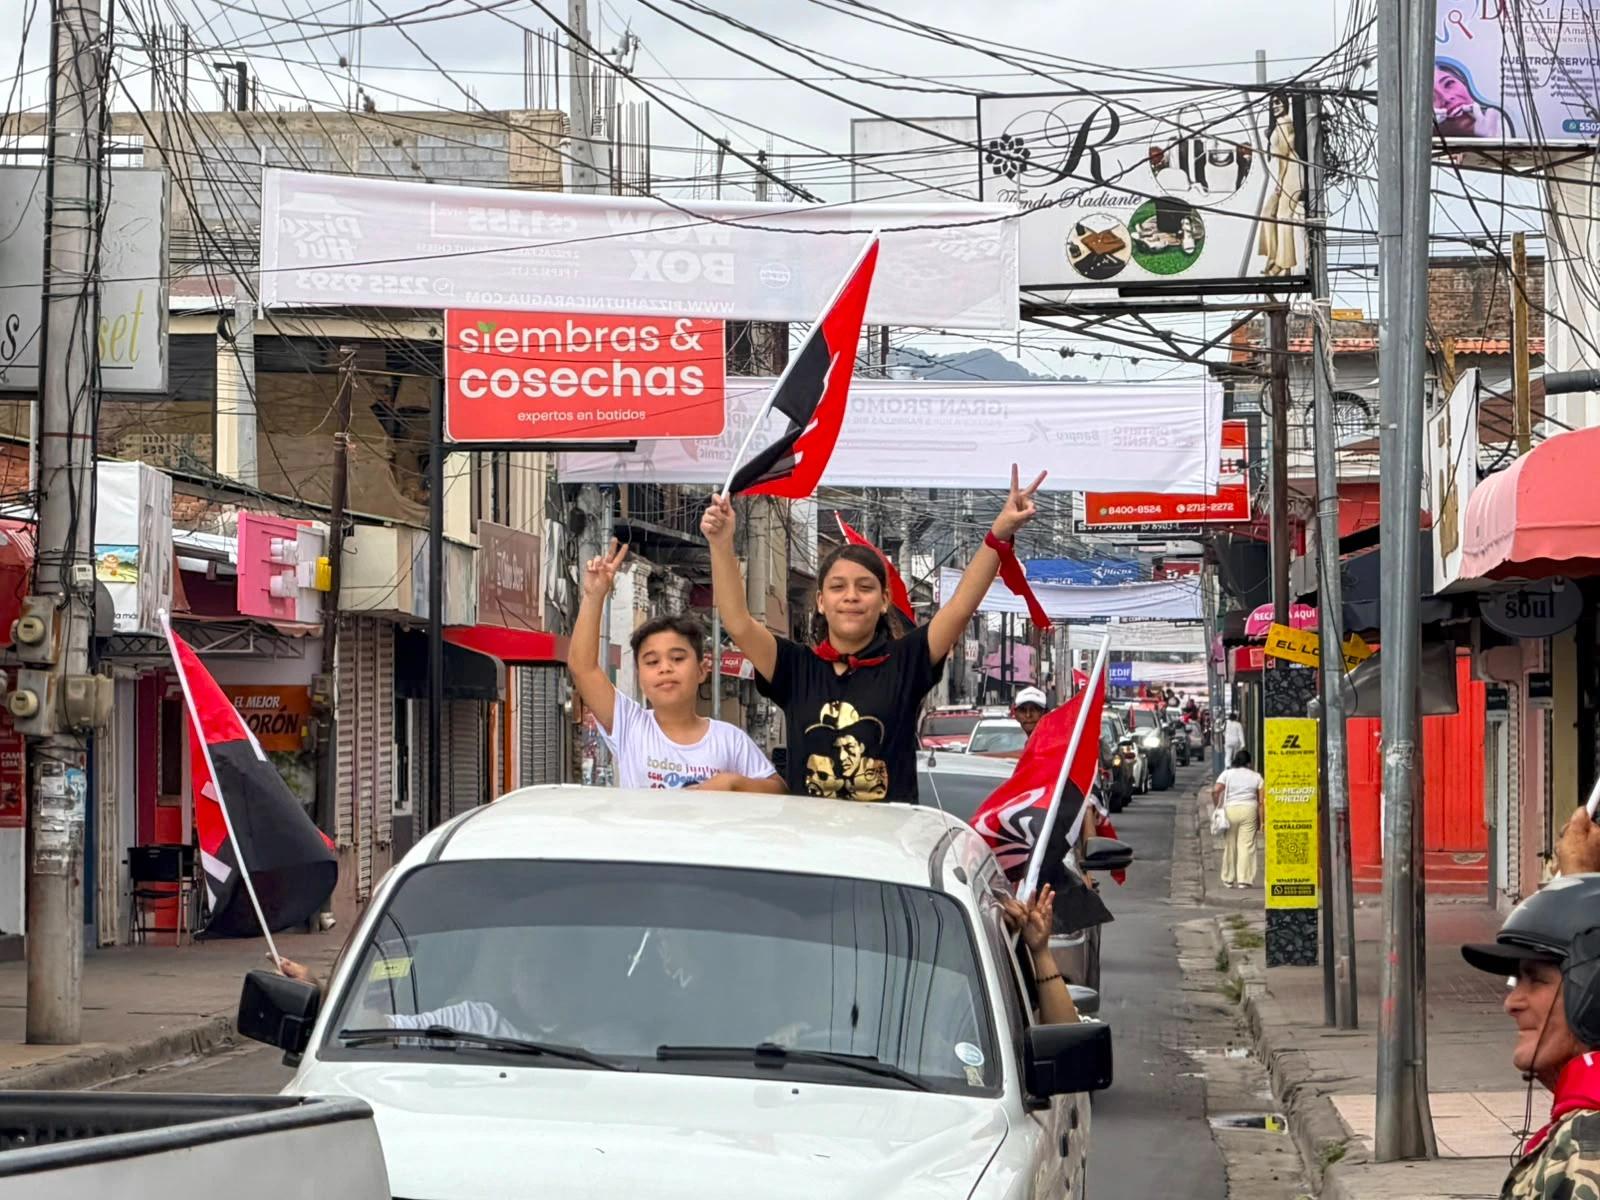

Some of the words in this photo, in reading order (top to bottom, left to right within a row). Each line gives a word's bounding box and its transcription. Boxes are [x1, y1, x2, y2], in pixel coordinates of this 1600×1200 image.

[1501, 57, 1556, 66] NUETROS
[1059, 187, 1141, 209] Radiante
[459, 319, 660, 354] siembras
[669, 318, 704, 353] &
[459, 359, 705, 398] cosechas
[517, 411, 574, 424] expertos
[577, 411, 593, 421] en
[596, 409, 646, 421] batidos
[1186, 503, 1234, 513] 2712-2272
[1505, 591, 1556, 619] soul
[1275, 639, 1297, 651] EL
[234, 696, 243, 708] EL
[246, 696, 280, 708] MEJOR
[647, 756, 683, 772] todos
